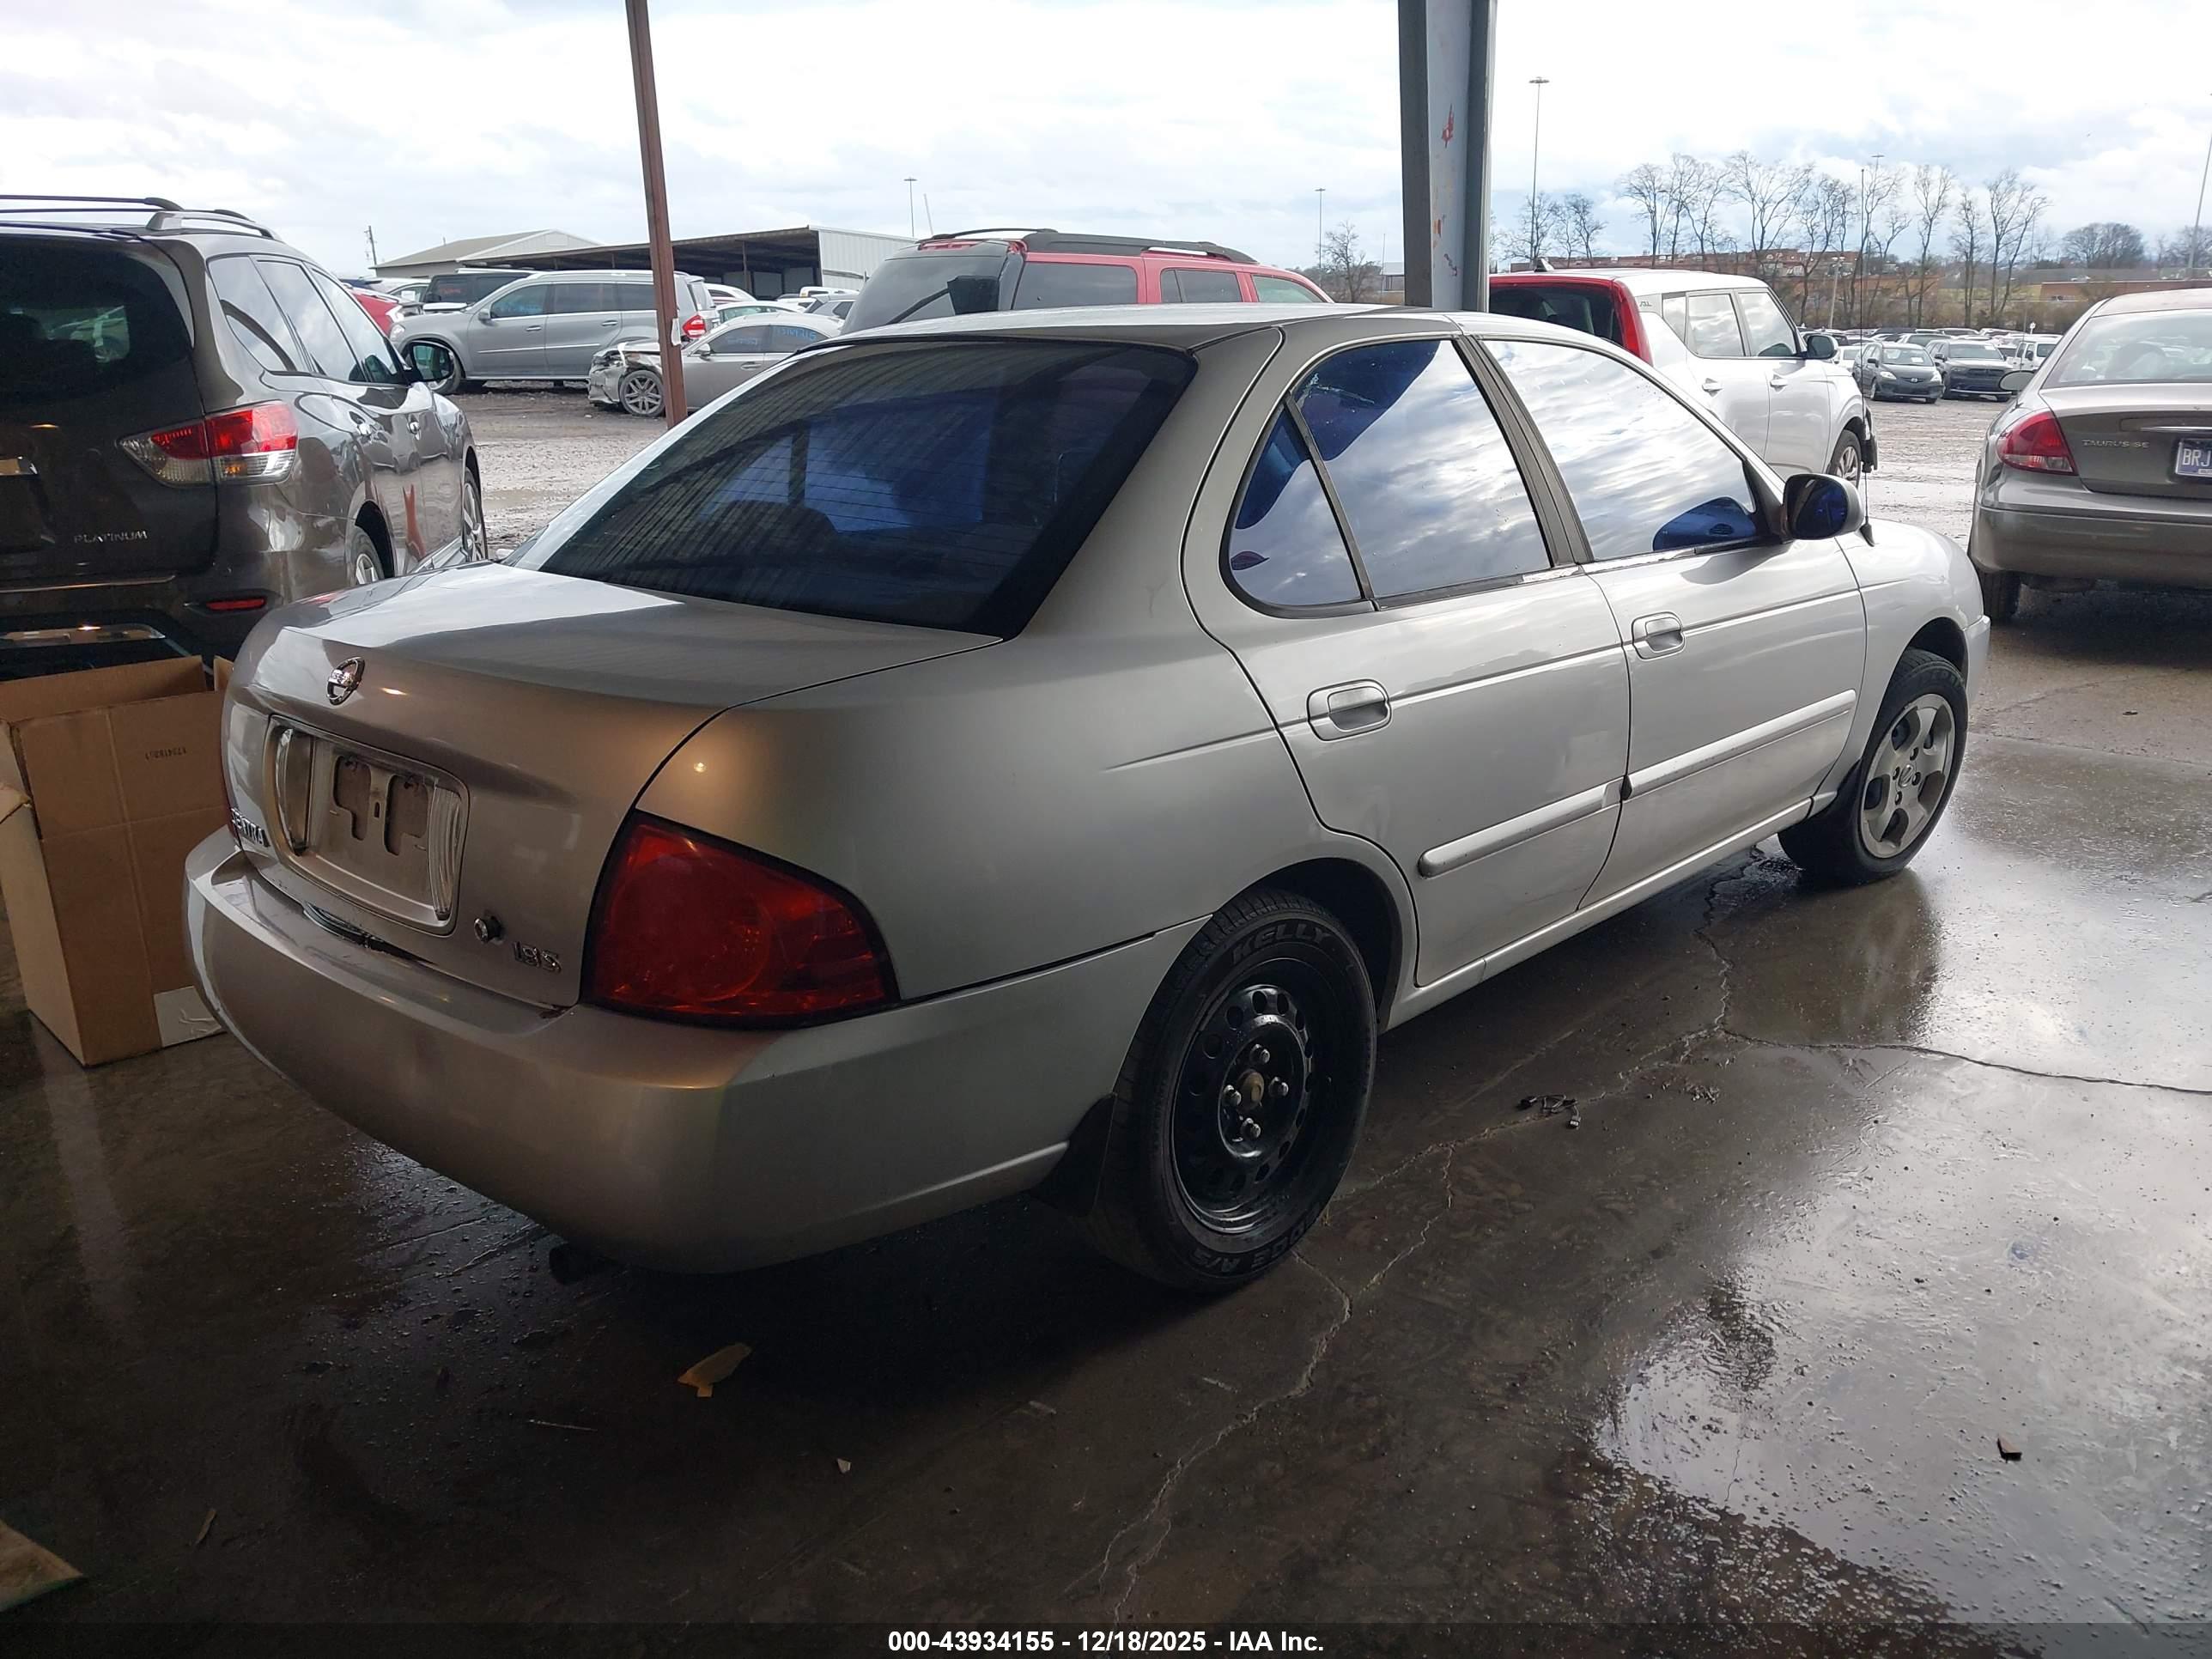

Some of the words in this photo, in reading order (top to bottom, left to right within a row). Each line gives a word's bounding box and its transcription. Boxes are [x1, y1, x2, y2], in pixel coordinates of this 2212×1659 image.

[2081, 439, 2130, 447] TAURUS
[73, 530, 148, 543] PLATINUM
[1231, 922, 1333, 966] KELLY
